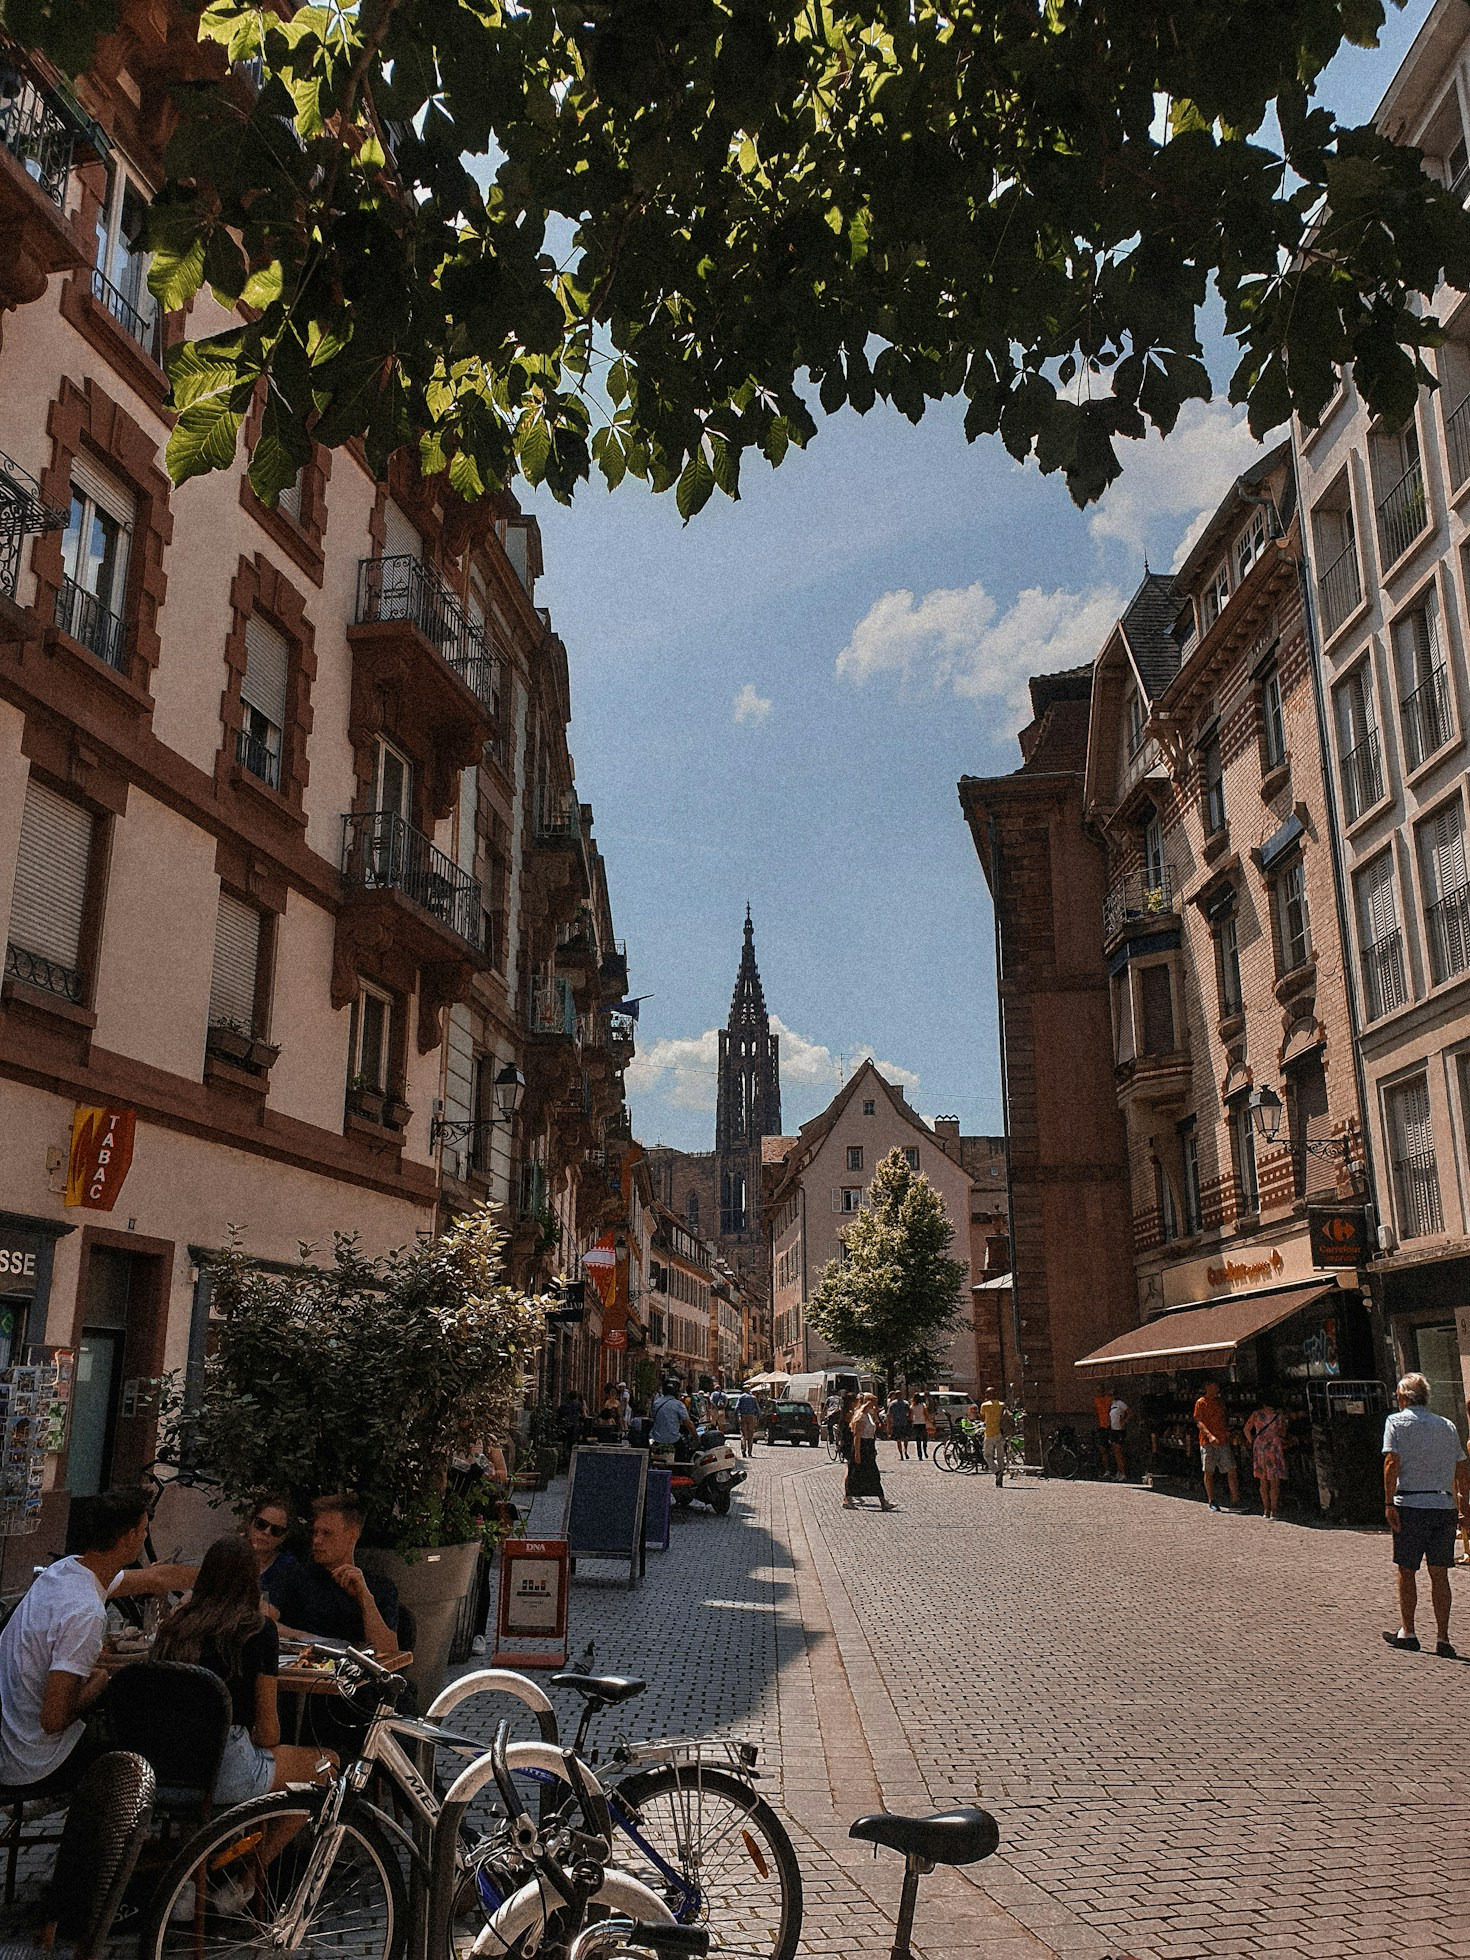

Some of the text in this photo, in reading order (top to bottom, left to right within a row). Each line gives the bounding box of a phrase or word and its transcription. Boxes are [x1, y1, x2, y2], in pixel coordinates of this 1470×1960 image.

[89, 1115, 121, 1200] TABAC
[1319, 1245, 1361, 1253] Carrefour
[1461, 1318, 1467, 1335] 9
[525, 1543, 546, 1551] DNA
